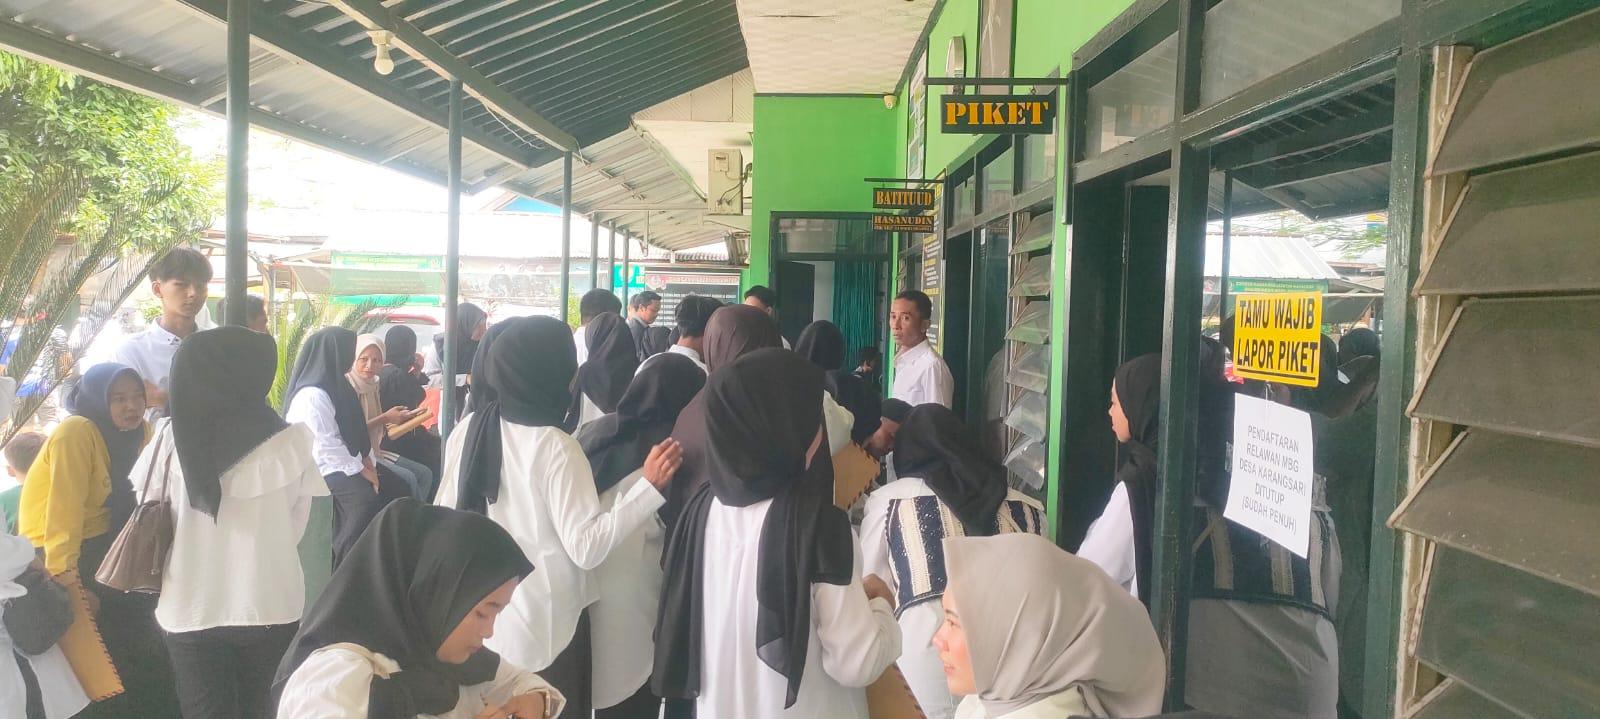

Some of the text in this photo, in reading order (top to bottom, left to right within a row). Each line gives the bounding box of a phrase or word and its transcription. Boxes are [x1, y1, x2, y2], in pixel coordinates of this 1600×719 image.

[945, 102, 1049, 125] PIKET
[876, 191, 932, 206] BATITUUD
[874, 216, 932, 225] HASANUDIN
[1239, 298, 1315, 329] TAMU WAJIB
[1237, 338, 1318, 373] LAPOR PIKET
[1247, 425, 1299, 453] PENDAFTARAN
[1246, 443, 1299, 473] RELAWAN MBG
[1240, 458, 1306, 496] DESA KARANGSARI
[1255, 483, 1285, 505] DITUTUP
[1242, 496, 1297, 535] (SUDAH PENUH)
